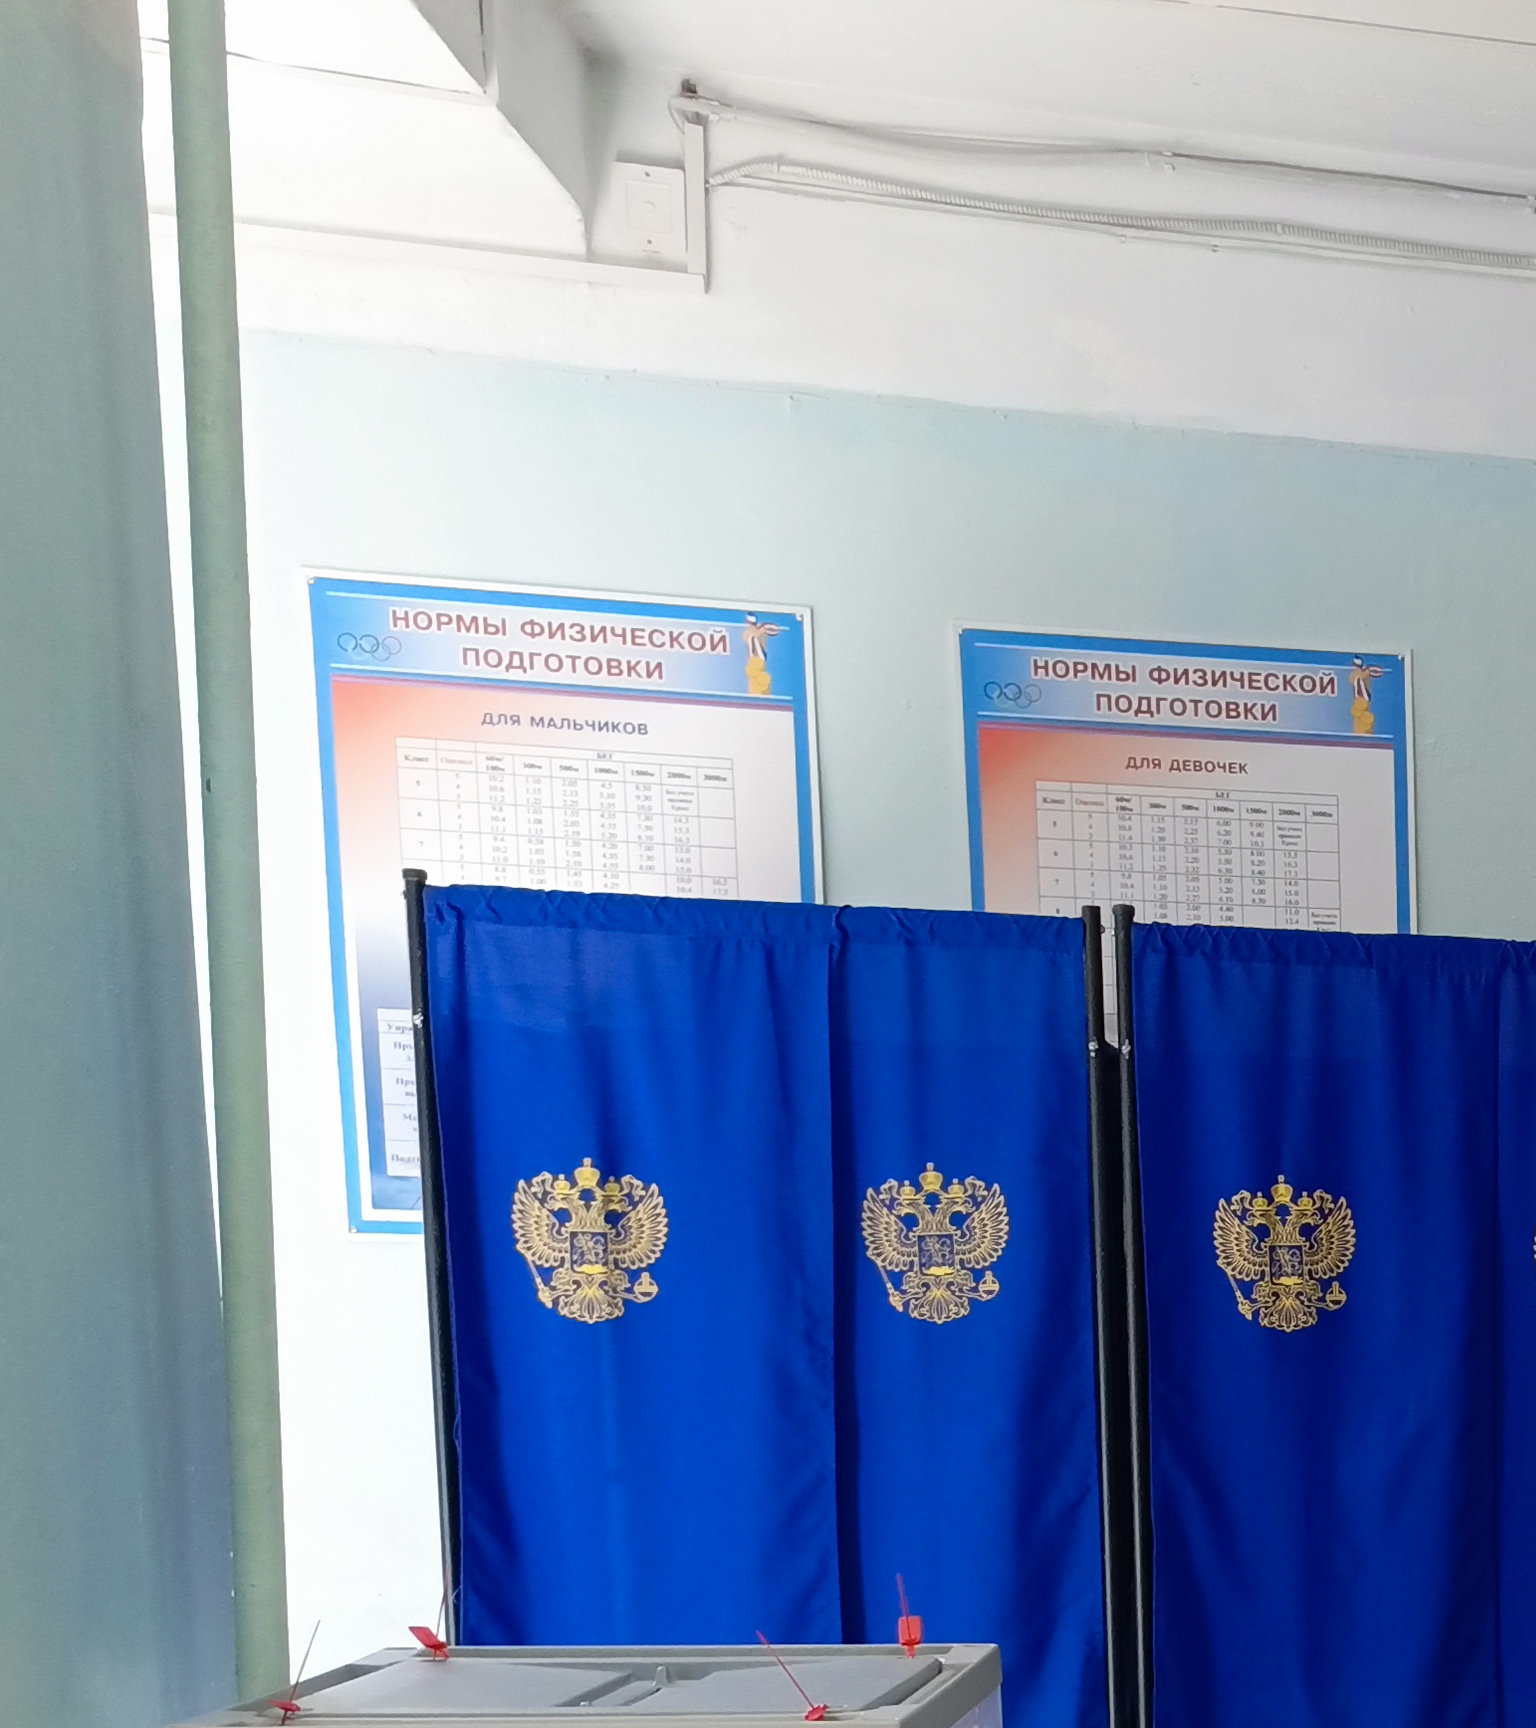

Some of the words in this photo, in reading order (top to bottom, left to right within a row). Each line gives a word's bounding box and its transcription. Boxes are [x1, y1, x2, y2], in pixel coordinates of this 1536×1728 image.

[391, 608, 507, 637] НОРМЫ
[520, 616, 729, 654] ФИЗИЧЕСКОЙ
[462, 646, 664, 681] ПОДГОТОВКИ
[1031, 658, 1136, 682] НОРМЫ
[1148, 665, 1336, 695] ФИЗИЧЕСКОЙ
[1096, 693, 1277, 722] ПОДГОТОВКИ
[481, 712, 521, 728] ДЛЯ
[530, 715, 649, 737] МАЛЬЧИКОВ
[1125, 756, 1162, 771] ДЛЯ
[1169, 759, 1249, 775] ДЕВОЧЕК
